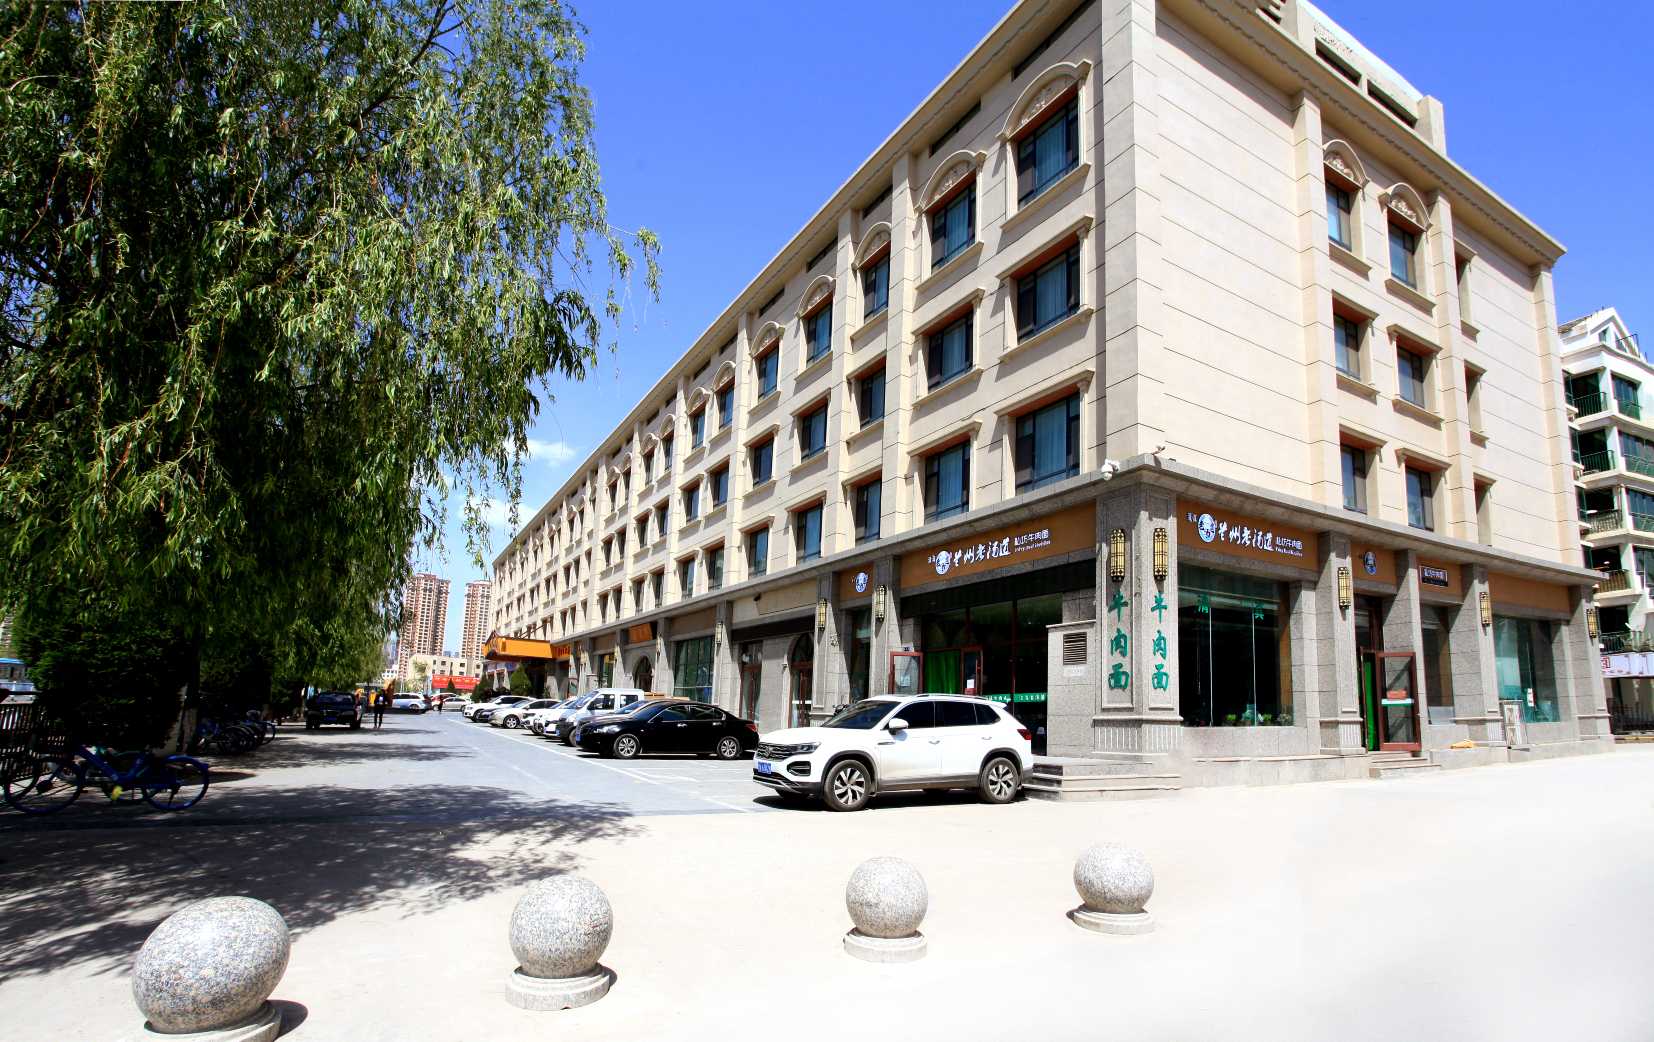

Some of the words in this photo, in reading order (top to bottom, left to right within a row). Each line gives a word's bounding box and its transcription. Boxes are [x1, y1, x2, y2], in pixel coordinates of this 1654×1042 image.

[1108, 588, 1130, 691] 牛肉面
[1151, 591, 1169, 691] 牛肉面
